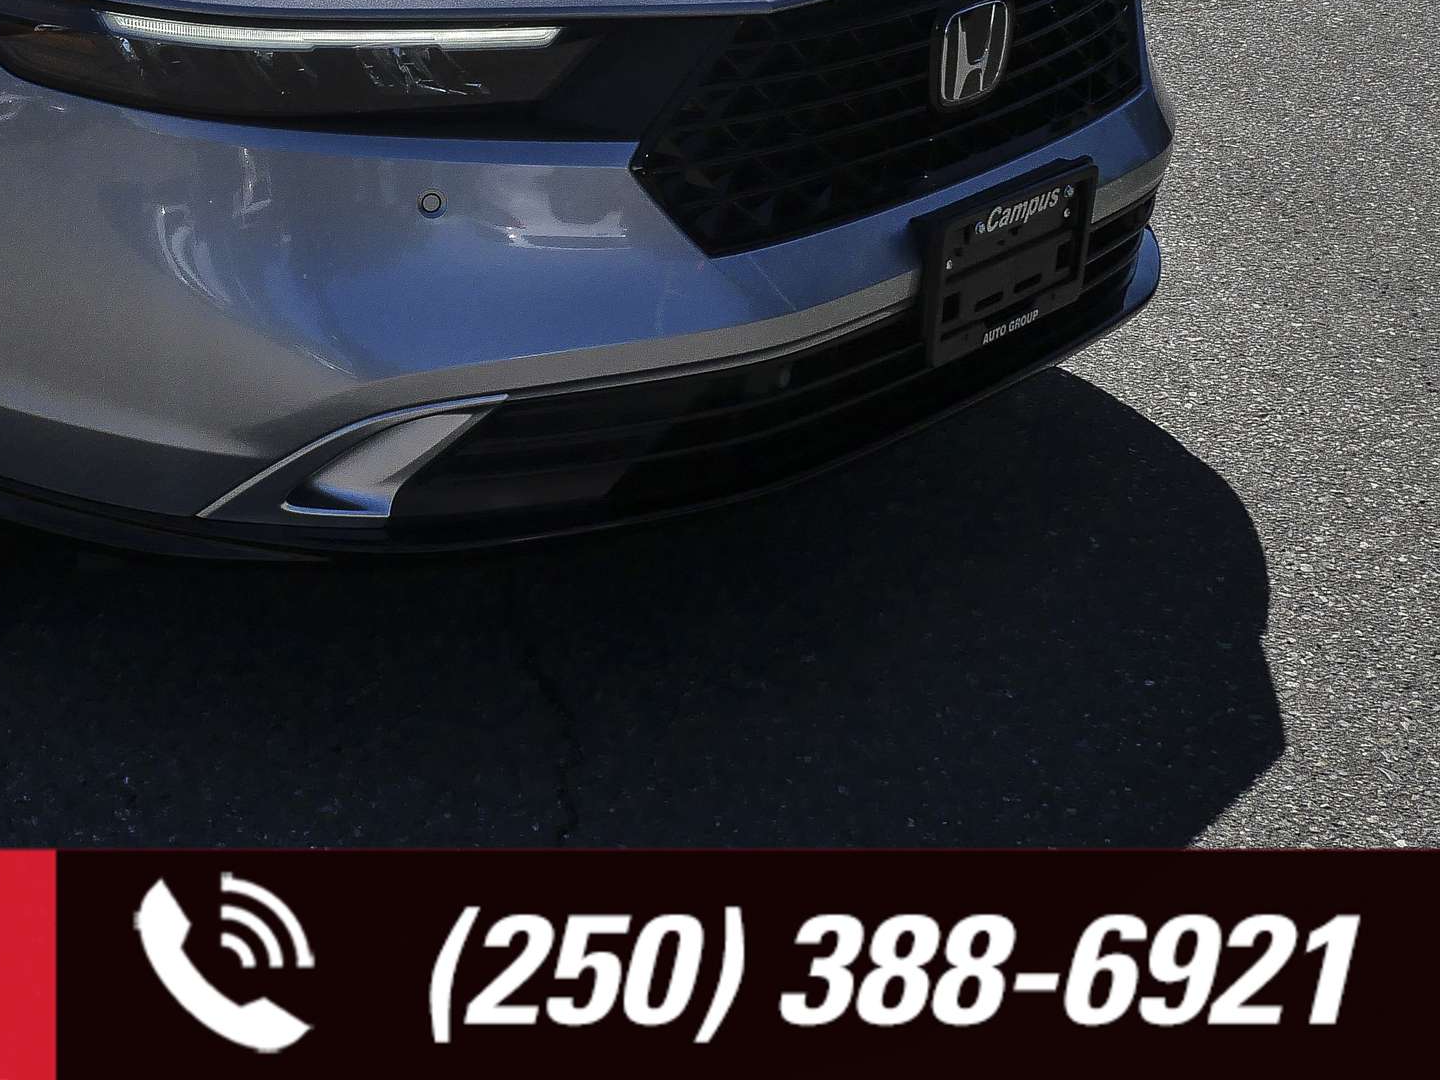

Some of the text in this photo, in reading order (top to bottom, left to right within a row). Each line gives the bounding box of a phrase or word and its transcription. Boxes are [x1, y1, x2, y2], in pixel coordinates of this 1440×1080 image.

[985, 187, 1061, 233] Campus
[982, 309, 1040, 345] AUTO GROUP
